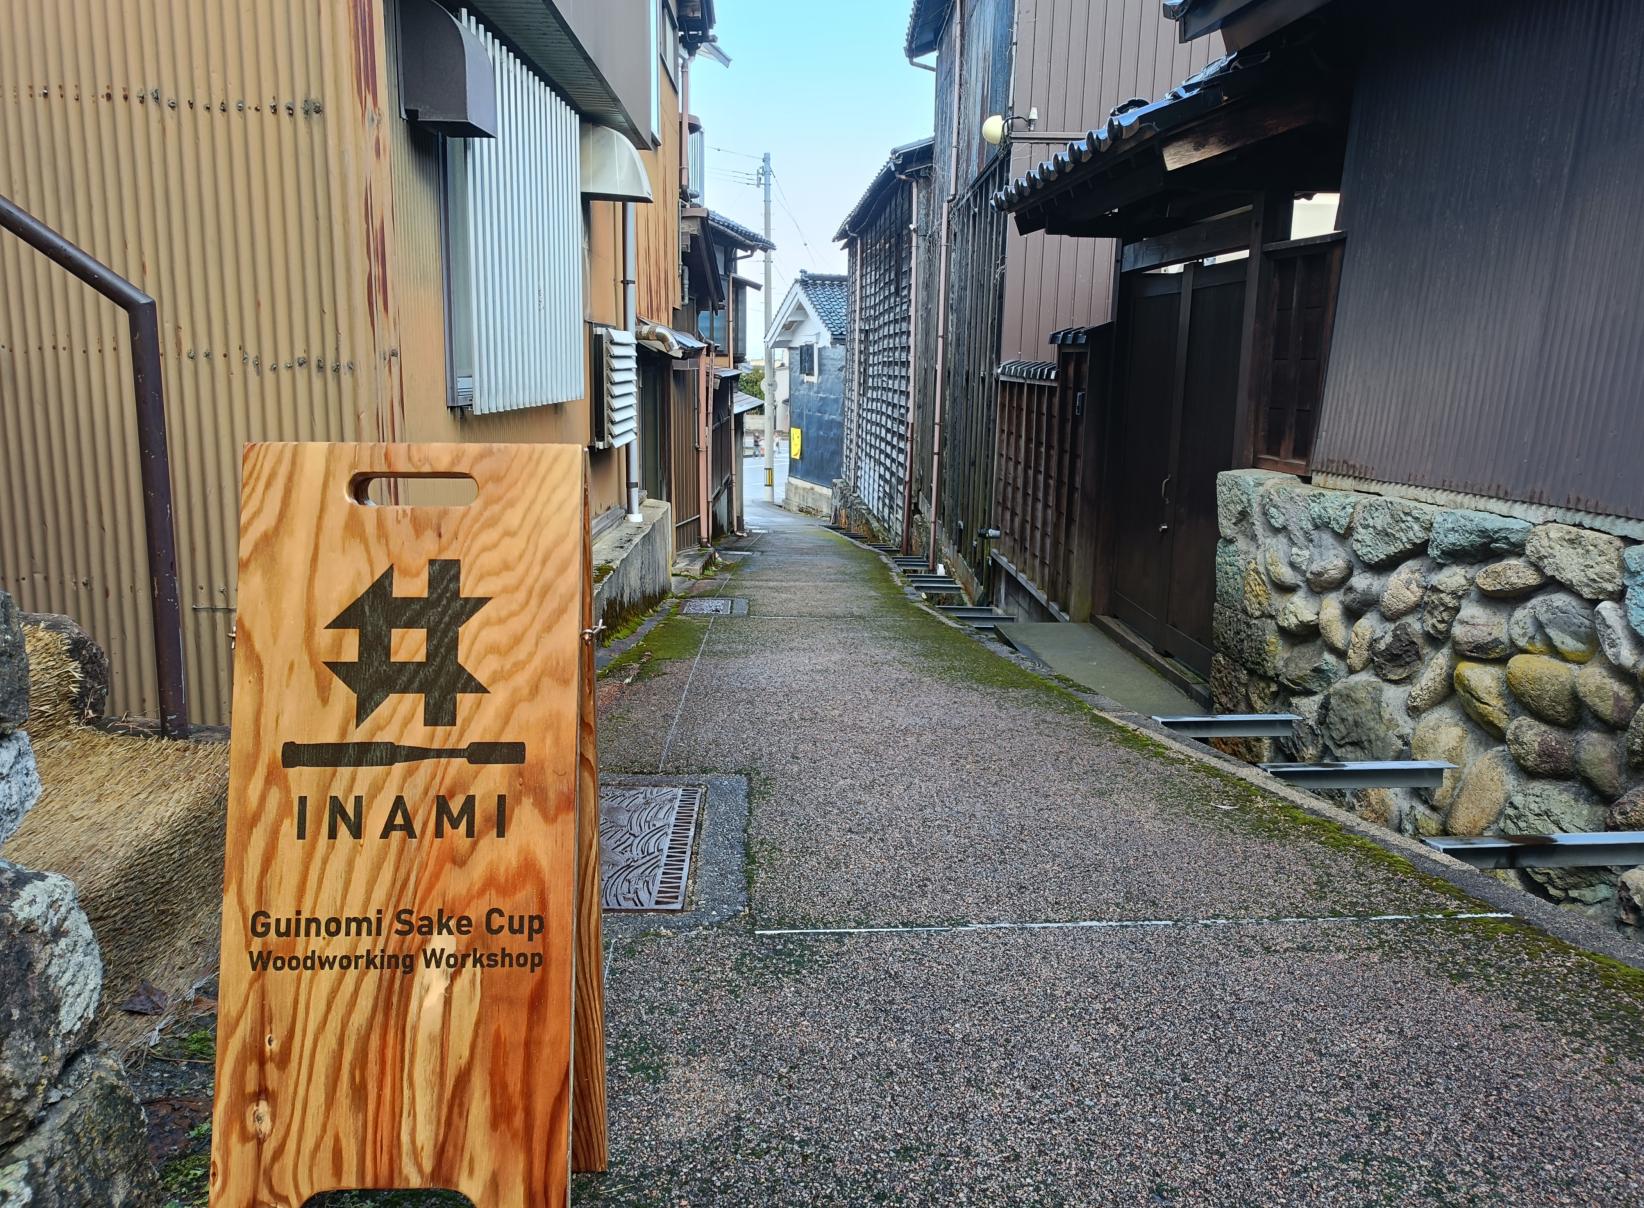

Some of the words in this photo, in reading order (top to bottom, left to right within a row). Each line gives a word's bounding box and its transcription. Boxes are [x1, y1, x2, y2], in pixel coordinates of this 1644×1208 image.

[296, 794, 507, 841] INAMI
[249, 909, 384, 938] Guinomi
[393, 908, 474, 936] Sake
[484, 907, 546, 941] Cup
[248, 950, 415, 975] Woodworking
[422, 948, 544, 973] Workshop
